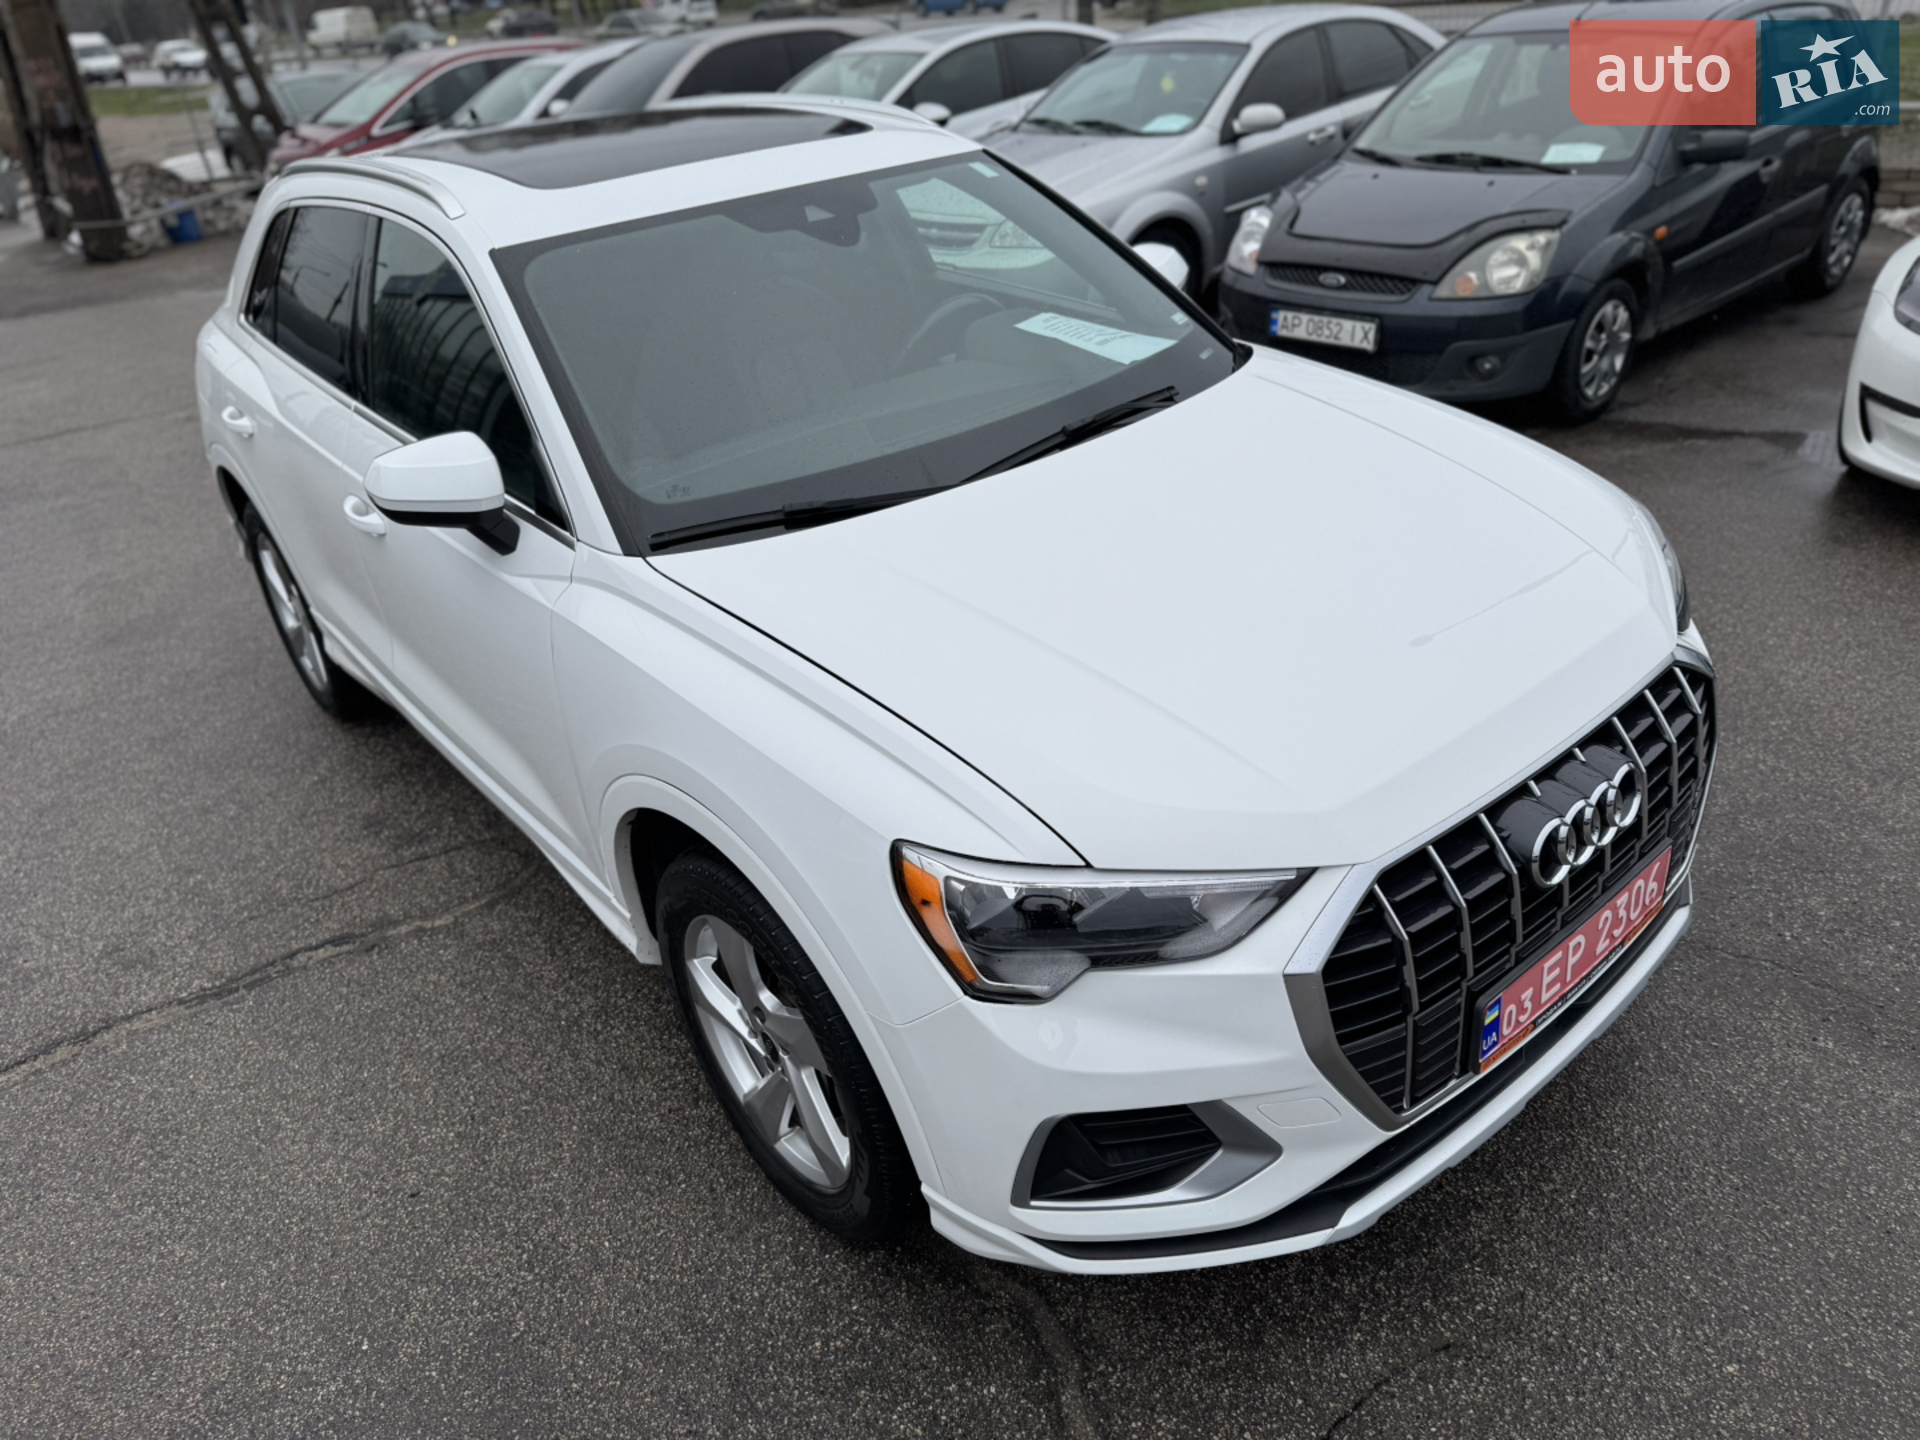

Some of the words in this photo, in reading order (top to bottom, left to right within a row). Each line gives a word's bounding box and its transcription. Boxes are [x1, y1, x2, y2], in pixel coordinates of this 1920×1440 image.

[1280, 313, 1303, 333] AP
[1305, 317, 1344, 341] 0852
[1502, 987, 1534, 1036] 03
[1541, 934, 1586, 1004] EP
[1595, 861, 1661, 957] 2306
[1482, 1031, 1498, 1051] UA
